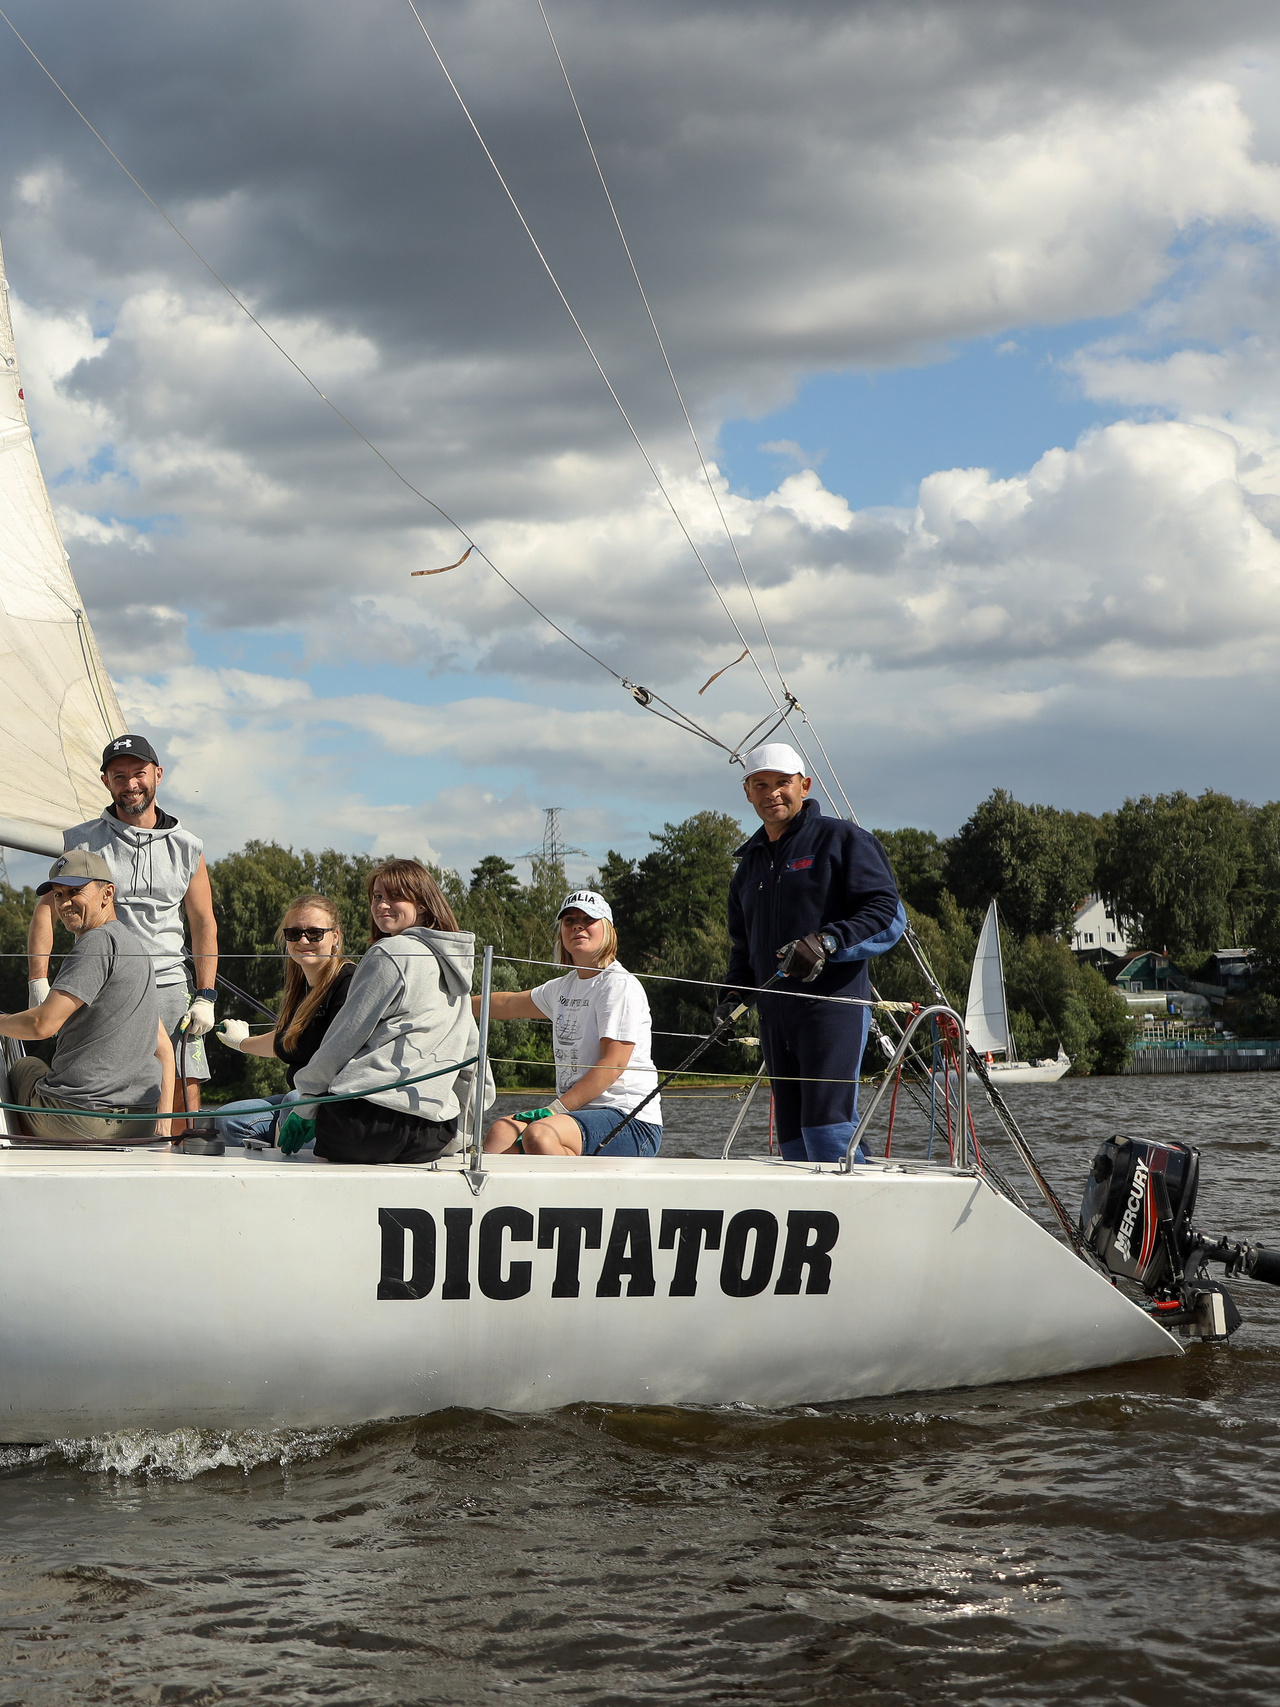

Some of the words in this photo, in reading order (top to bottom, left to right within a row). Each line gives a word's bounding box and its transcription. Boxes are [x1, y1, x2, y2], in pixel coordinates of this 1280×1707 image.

[564, 893, 596, 907] ITALIA
[377, 1206, 840, 1300] DICTATOR
[1113, 1157, 1150, 1262] MERCURY
